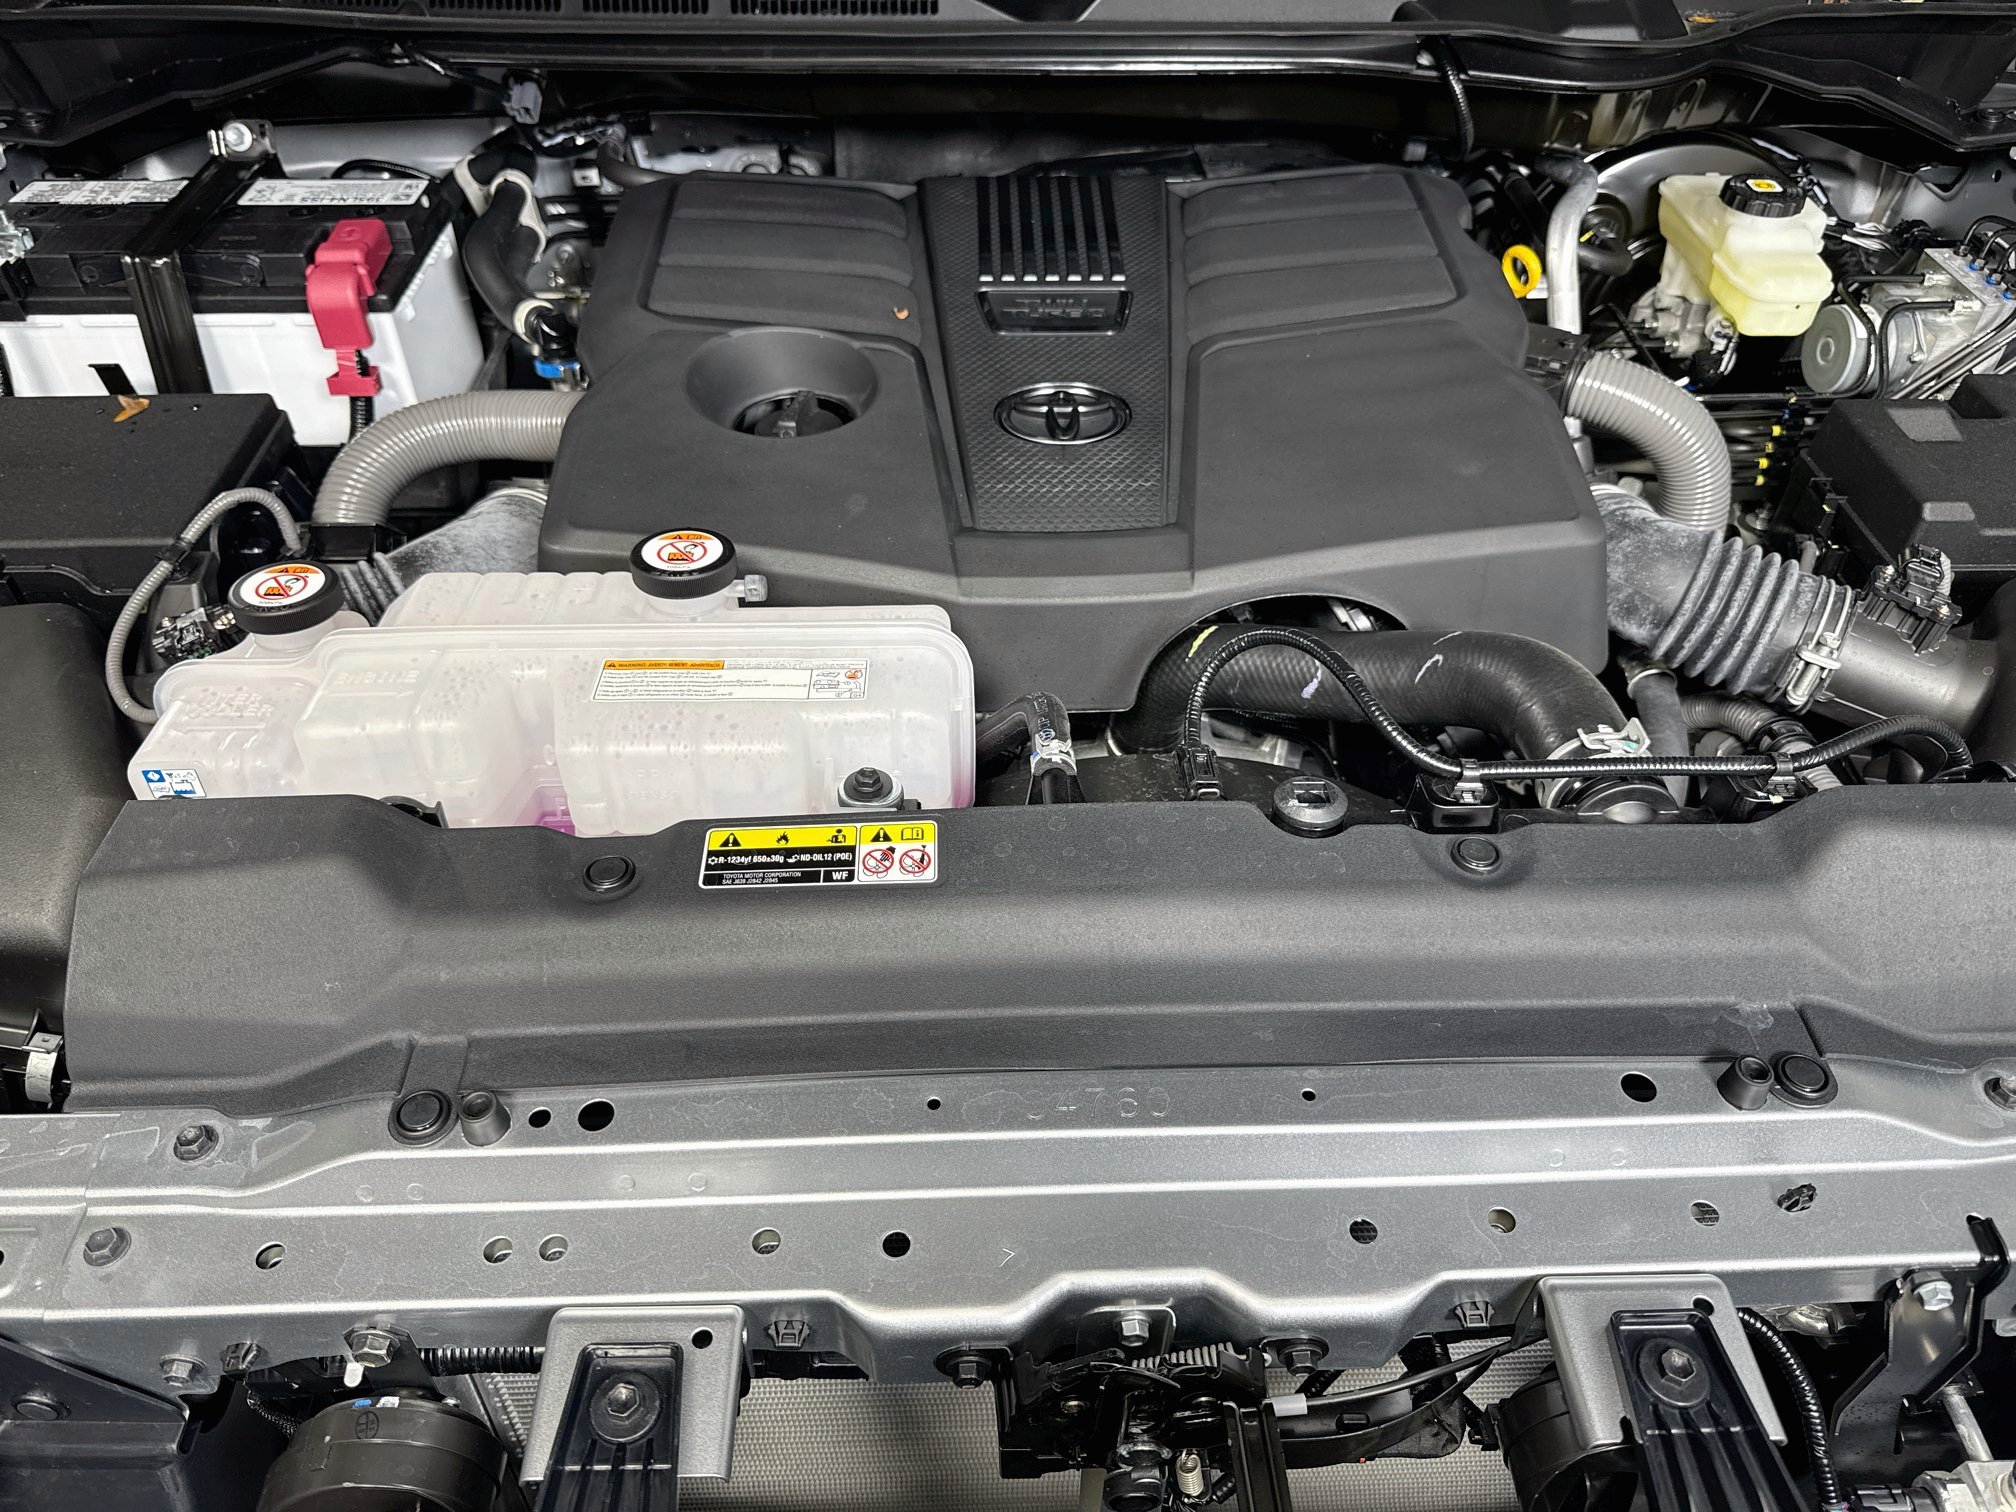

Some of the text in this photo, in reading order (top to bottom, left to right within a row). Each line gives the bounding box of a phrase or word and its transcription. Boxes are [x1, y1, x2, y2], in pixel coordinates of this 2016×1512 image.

[333, 670, 420, 685] ENGINE
[718, 855, 751, 864] R-1234yf
[753, 854, 784, 863] 650±30g
[833, 853, 853, 861] (POE)
[832, 871, 849, 880] WF
